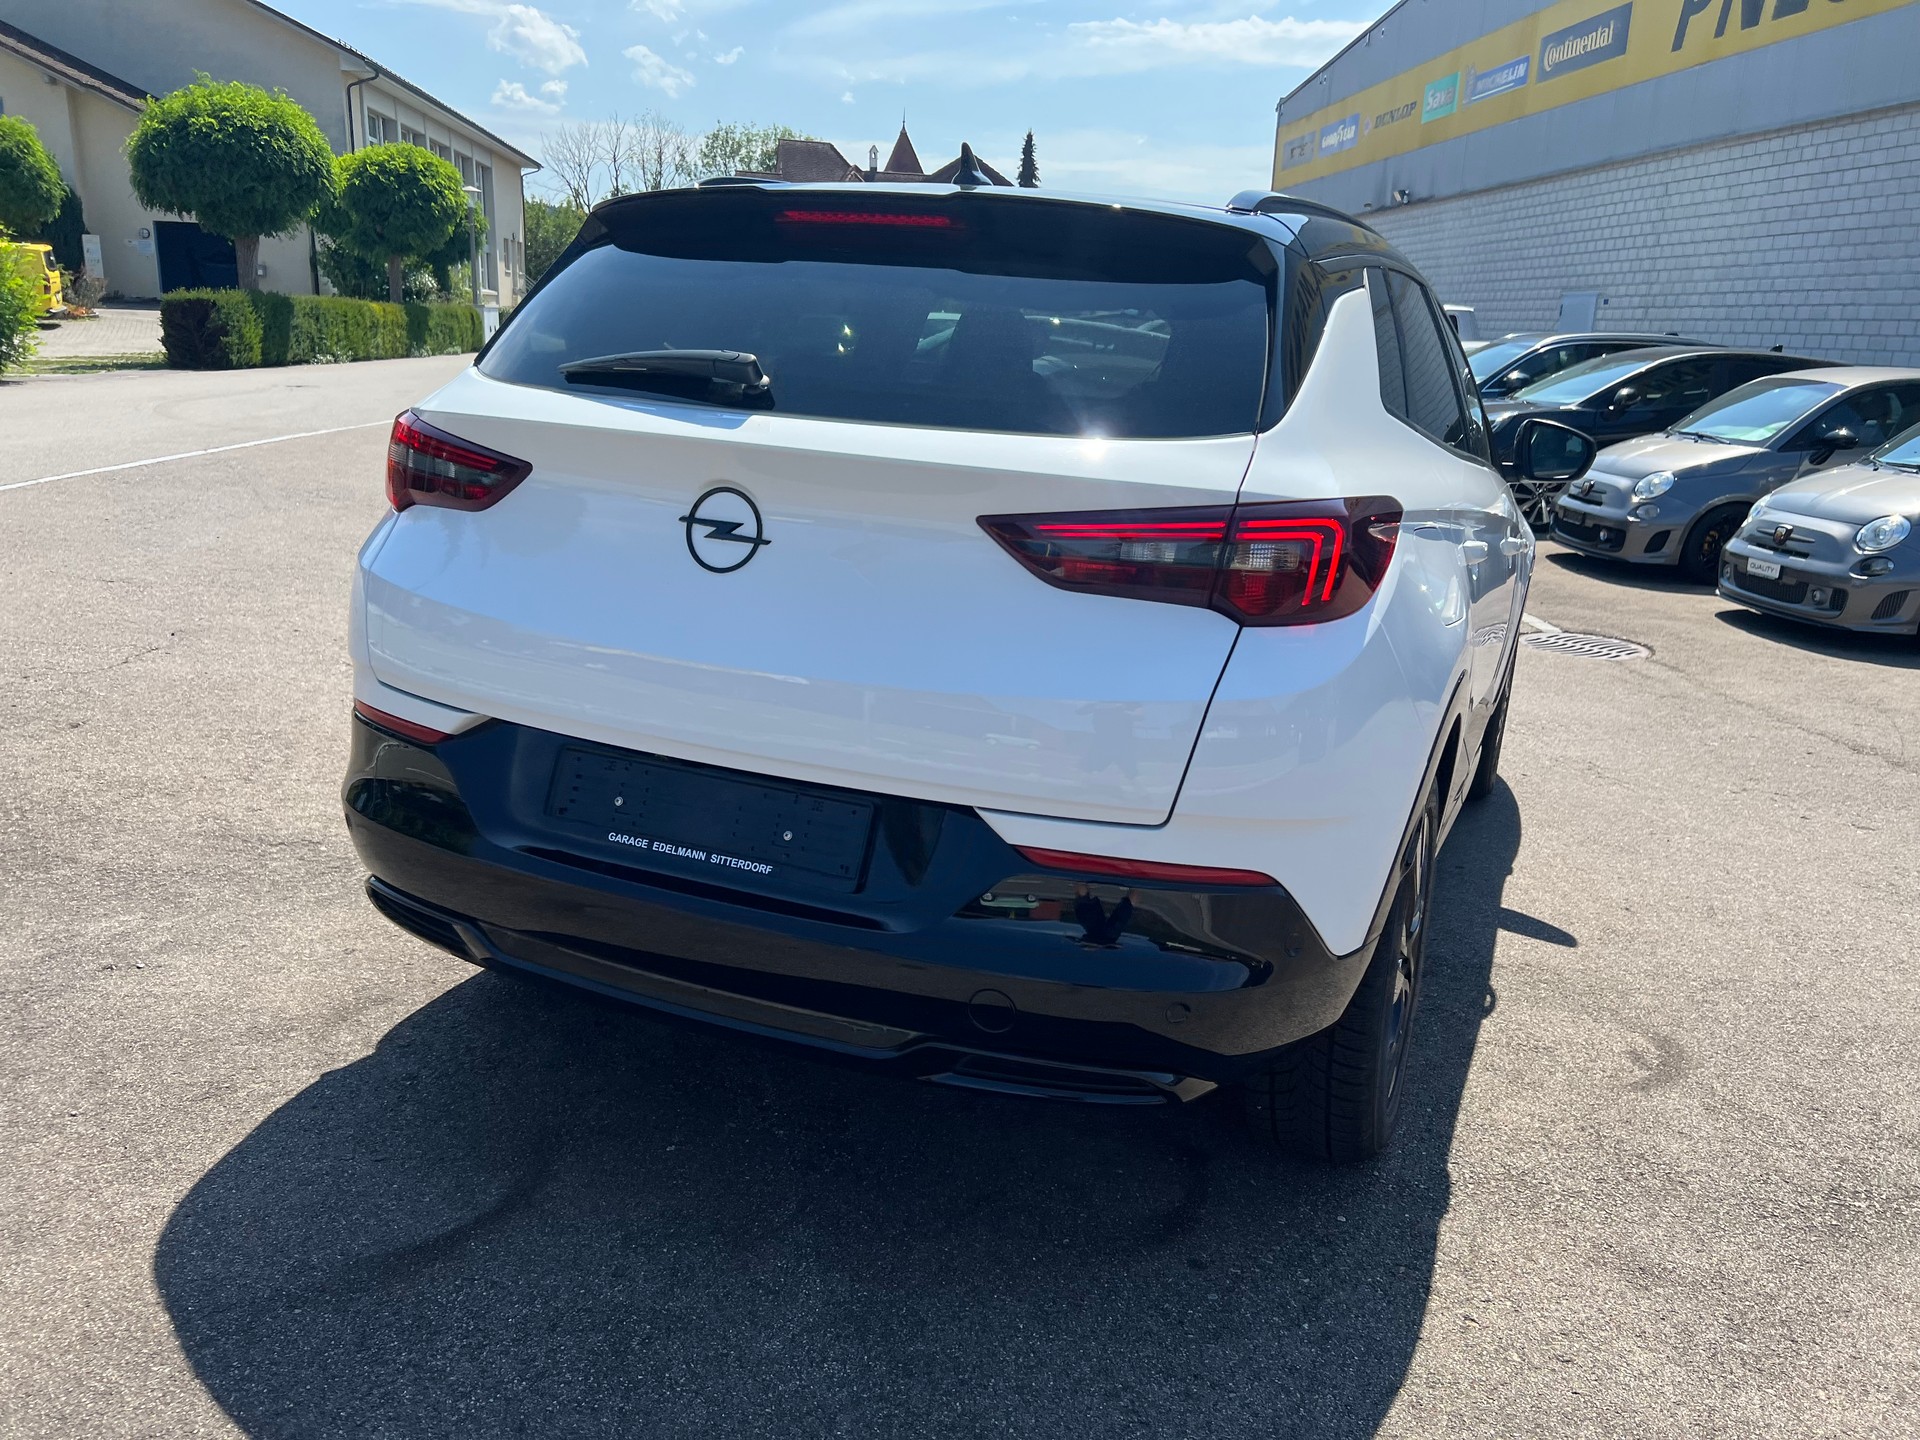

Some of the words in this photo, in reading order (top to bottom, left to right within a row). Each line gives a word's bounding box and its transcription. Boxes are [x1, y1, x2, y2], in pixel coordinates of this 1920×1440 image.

[1543, 20, 1615, 72] Continental
[1476, 62, 1528, 91] MICHELIN
[1374, 101, 1417, 129] DUNLOP
[1750, 562, 1775, 573] QUALITY
[608, 832, 649, 849] GARAGE
[652, 841, 707, 861] EDELMANN
[710, 854, 773, 875] SITTERDORF
